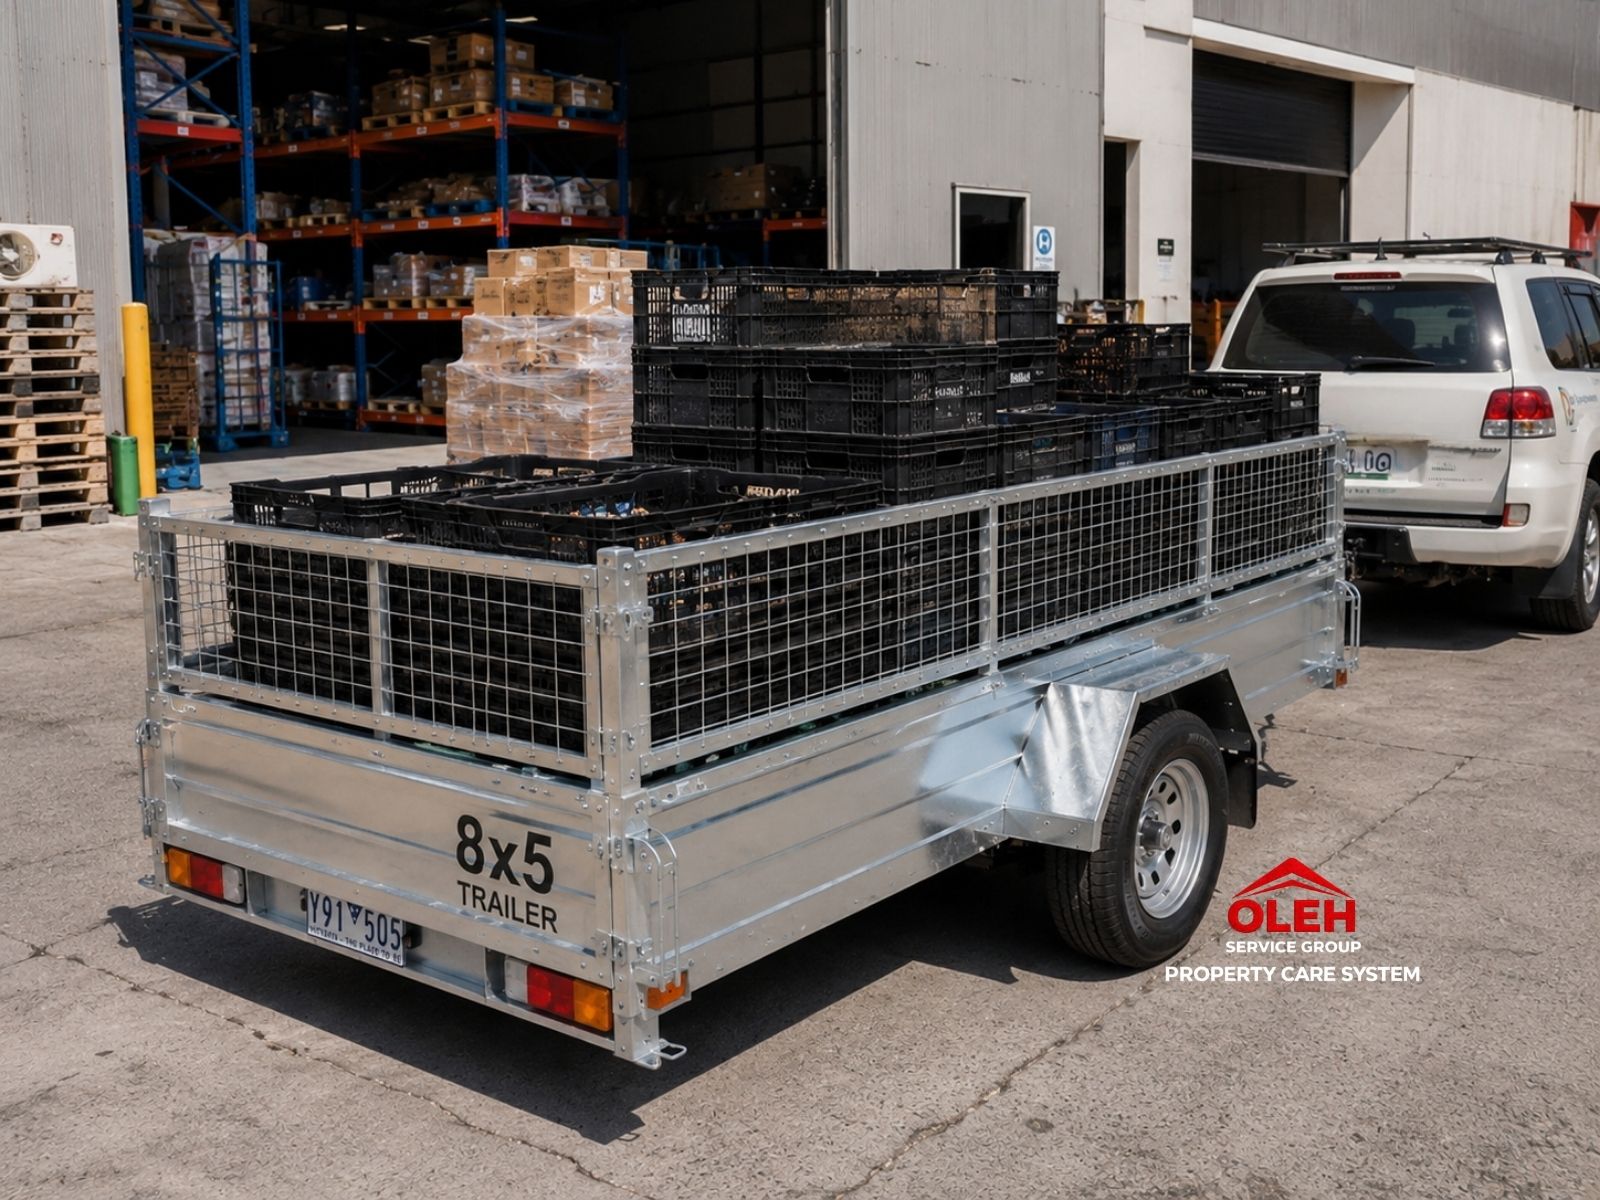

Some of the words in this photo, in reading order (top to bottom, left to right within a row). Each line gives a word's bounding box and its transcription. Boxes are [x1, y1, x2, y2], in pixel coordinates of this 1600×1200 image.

[456, 814, 554, 894] 8x5
[310, 891, 342, 932] Y91
[364, 909, 401, 951] 505
[457, 880, 558, 934] TRAILER
